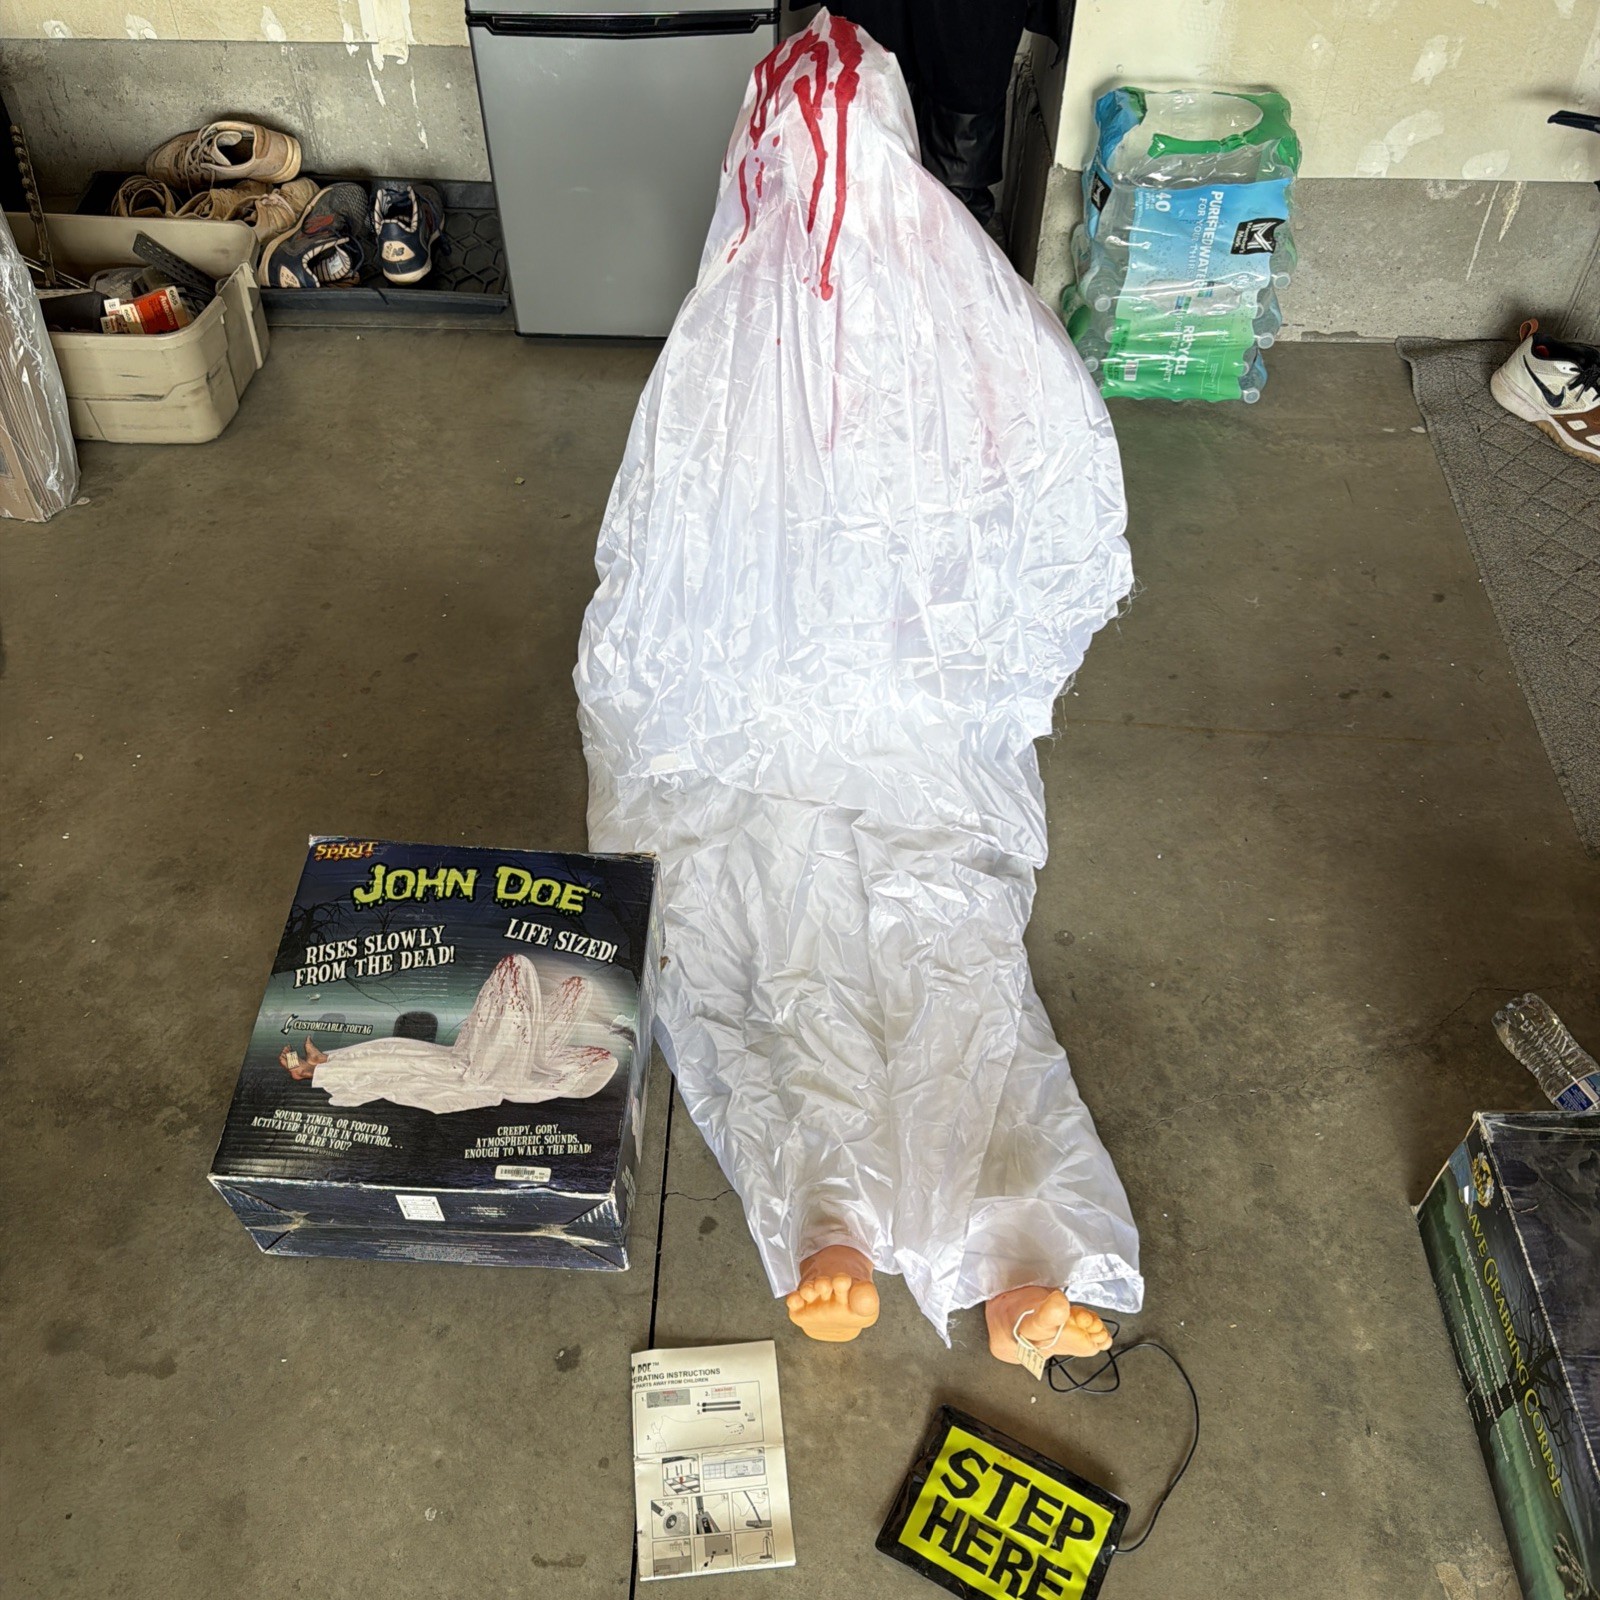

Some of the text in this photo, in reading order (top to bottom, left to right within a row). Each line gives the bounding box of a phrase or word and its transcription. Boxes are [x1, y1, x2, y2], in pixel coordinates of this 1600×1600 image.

[1155, 192, 1172, 212] 40
[1198, 197, 1208, 216] FOR
[315, 841, 377, 860] SPIRIT
[352, 864, 478, 907] JOHN
[304, 925, 446, 965] RISES SLOWLY
[504, 918, 553, 946] LIFE
[554, 931, 619, 963] SIZED!
[293, 945, 456, 988] FROM THE DEAD!
[293, 1020, 344, 1033] CUSTOMIZABLE
[251, 1116, 300, 1132] ACTIVATED!
[303, 1124, 320, 1135] YOU
[322, 1127, 338, 1138] ARE
[341, 1130, 352, 1140] IN
[336, 1119, 349, 1129] OR
[350, 1121, 389, 1135] FOOTPAD
[295, 1134, 307, 1144] OR
[309, 1136, 326, 1147] ARE
[329, 1139, 352, 1151] YOU?
[464, 1143, 592, 1159] ENOUGH TO WAKE THE DEAD!
[631, 1368, 721, 1384] ERATING INSTRUCTIONS
[1484, 1258, 1529, 1386] GRABBING
[1524, 1388, 1563, 1498] CORPSE
[940, 1447, 1096, 1553] STEP
[918, 1494, 1073, 1600] HERE
